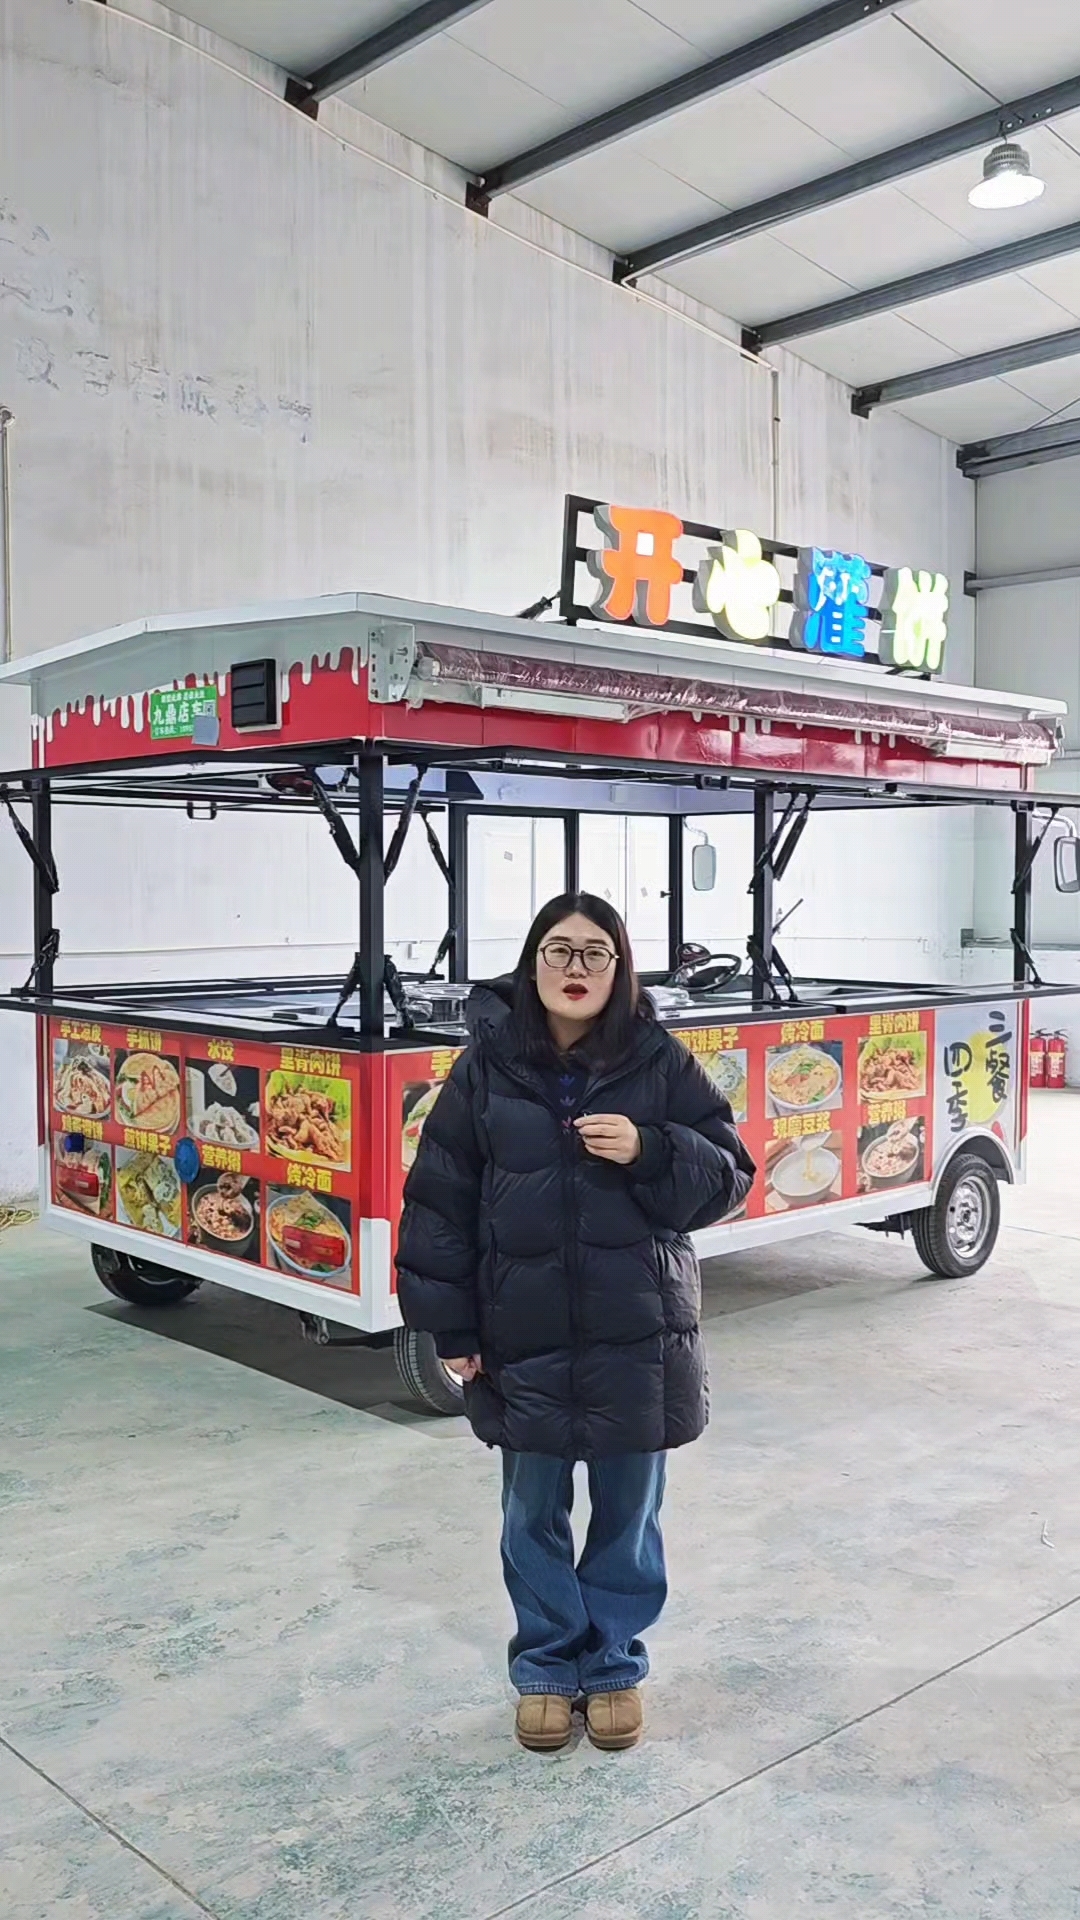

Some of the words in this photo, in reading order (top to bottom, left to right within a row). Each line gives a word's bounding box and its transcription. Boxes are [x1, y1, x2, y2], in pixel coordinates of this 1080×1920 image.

[781, 1020, 826, 1043] 烤冷面
[207, 1039, 235, 1062] 水饺
[431, 1049, 461, 1078] 手
[287, 1162, 333, 1193] 烤冷面
